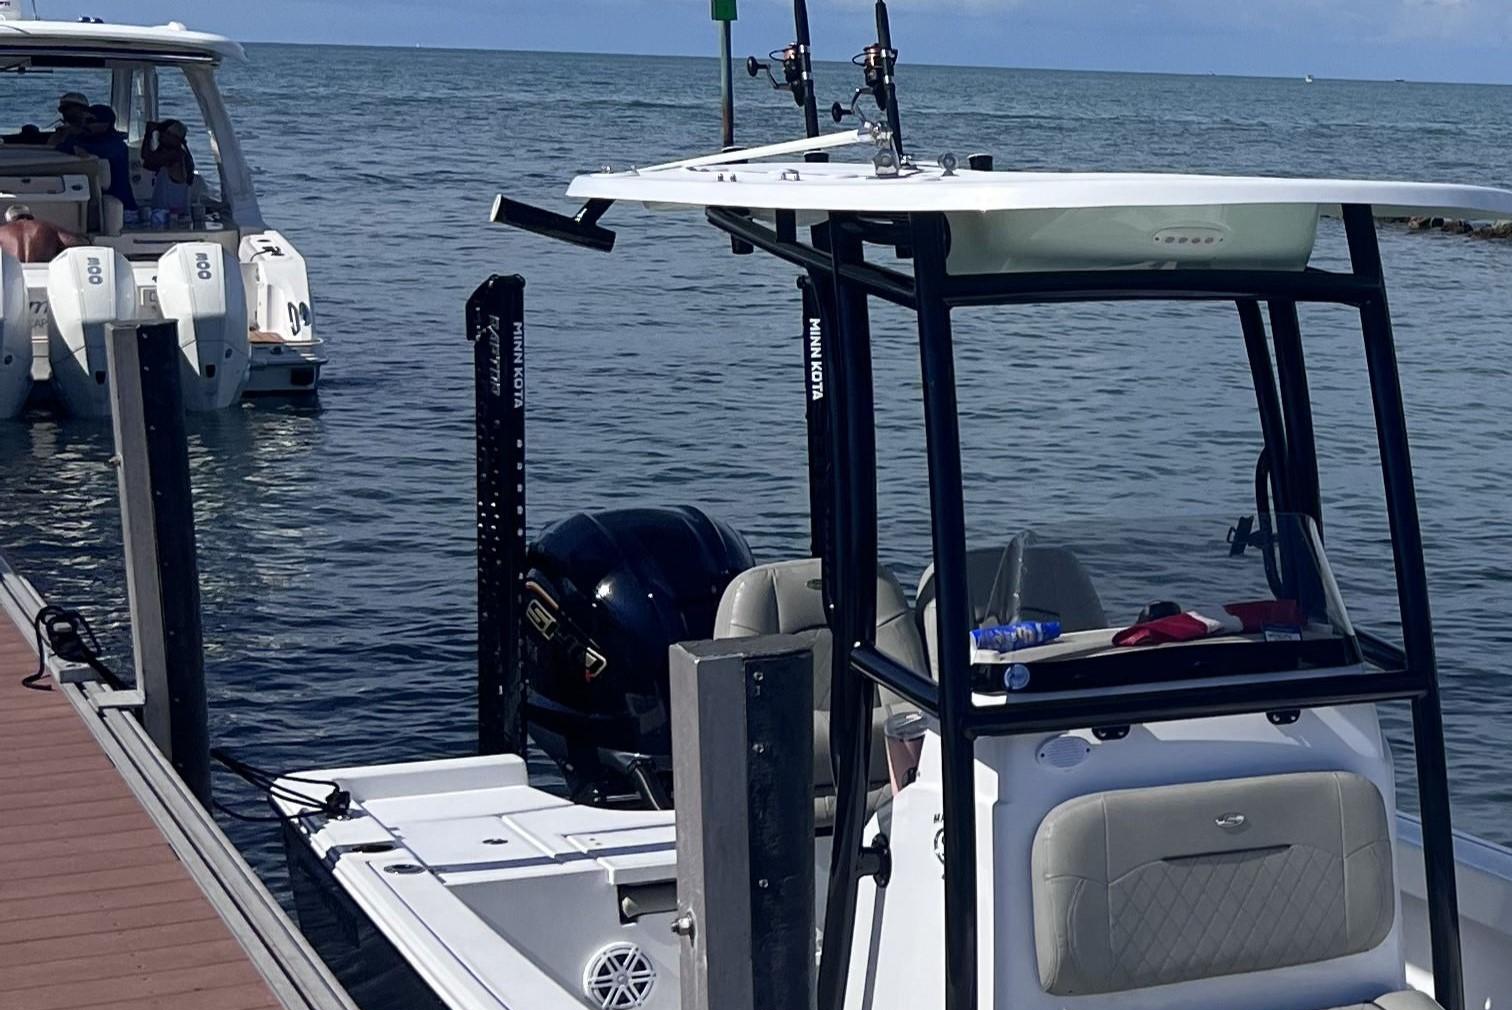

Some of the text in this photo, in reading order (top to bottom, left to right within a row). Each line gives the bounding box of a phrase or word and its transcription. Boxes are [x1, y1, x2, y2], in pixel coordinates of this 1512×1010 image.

[87, 257, 103, 285] 300
[195, 252, 212, 280] 300
[513, 321, 524, 409] MINN KOTA
[809, 318, 823, 401] MINN KOTA
